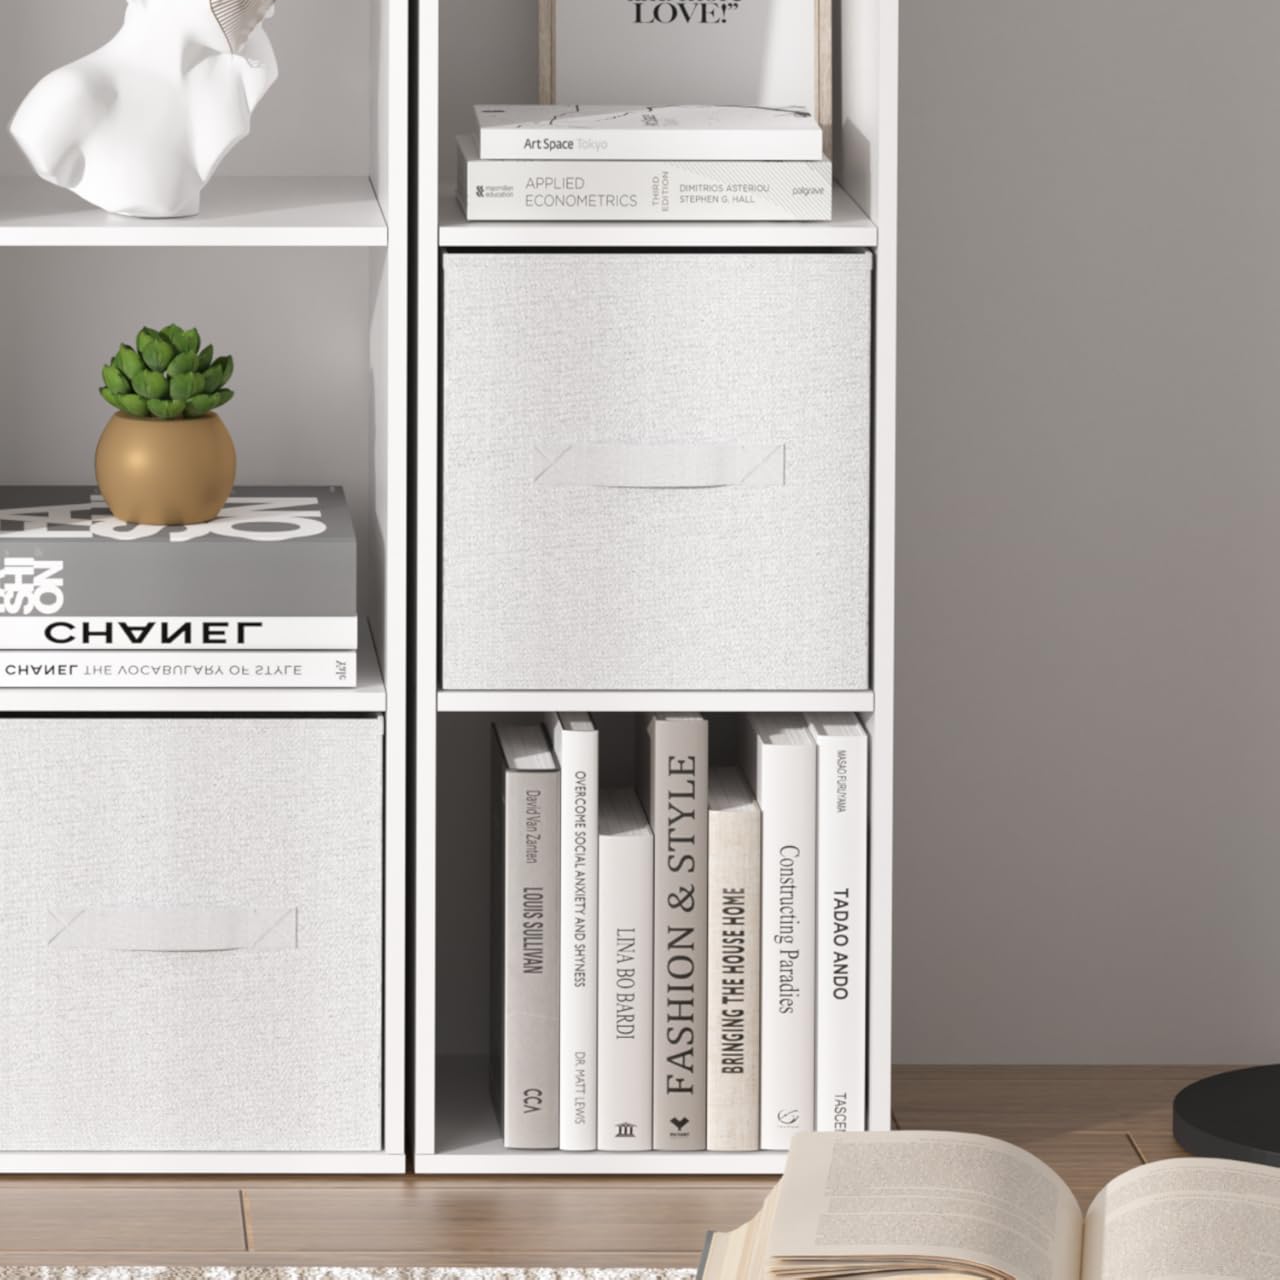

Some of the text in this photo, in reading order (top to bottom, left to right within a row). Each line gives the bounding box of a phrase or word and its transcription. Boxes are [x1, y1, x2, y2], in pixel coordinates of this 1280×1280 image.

[524, 137, 608, 152] Art Space Tokyo
[525, 177, 585, 190] APPLIED
[525, 194, 638, 208] ECONOMETRICS
[651, 175, 659, 206] THIRD
[661, 171, 670, 212] EDITION
[680, 184, 770, 193] DIMITRIOS ASTERIOU
[680, 196, 720, 204] STEPHEN
[732, 196, 755, 204] HALL
[527, 790, 541, 864] David Van Zanten
[574, 771, 586, 988] OVERCOME SOCIAL ANXIETY AND SHYNESS
[523, 887, 544, 975] LOUIS SULLIVAN
[667, 756, 695, 1095] FASHION & STYLE
[774, 845, 801, 1015] Constructing Paradies
[833, 888, 850, 1001] TADAO ANDO
[616, 928, 636, 1040] LINA BO BARDI
[721, 888, 746, 1075] BRINGING THE HOUSE HOME
[575, 1069, 586, 1095] MATT
[575, 1097, 586, 1125] LEWIS
[834, 1093, 847, 1132] TASCE
